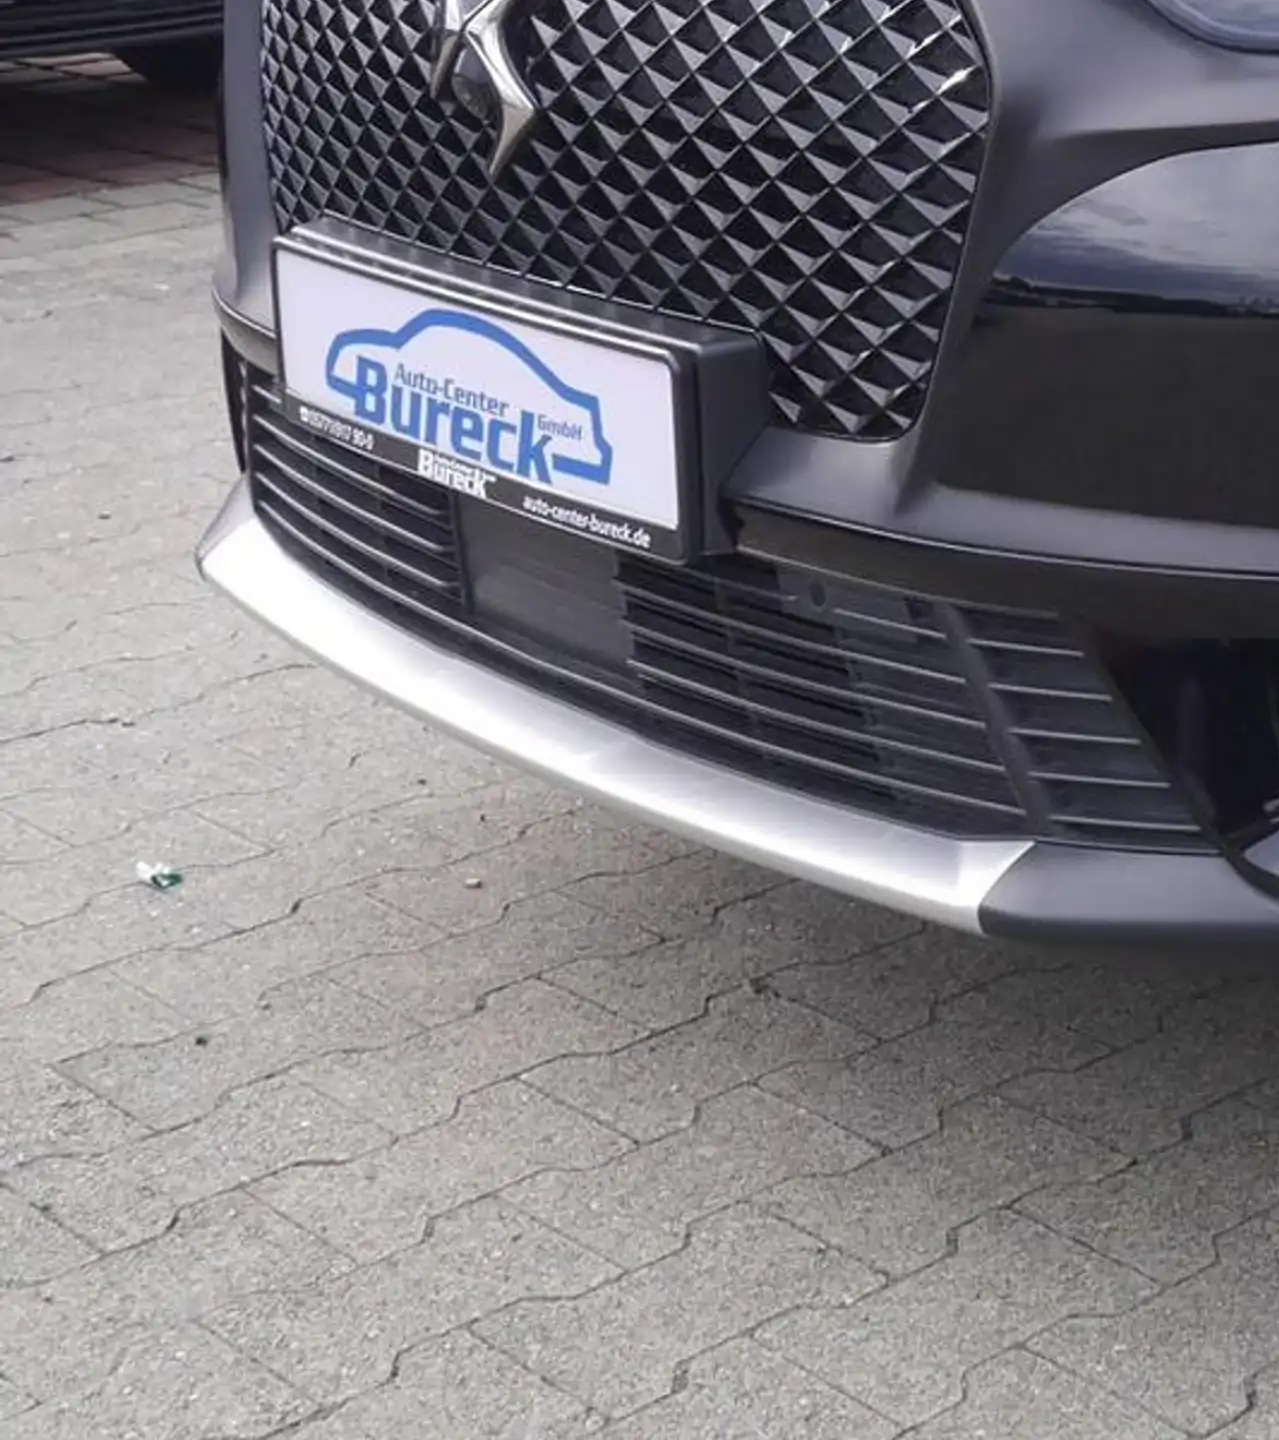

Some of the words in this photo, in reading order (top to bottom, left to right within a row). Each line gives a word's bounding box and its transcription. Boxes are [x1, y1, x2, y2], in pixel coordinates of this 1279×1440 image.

[393, 363, 509, 418] Auto-Center
[354, 355, 553, 485] Bureck
[537, 414, 583, 441] GmbH
[417, 448, 486, 500] Bureck
[522, 496, 651, 549] auto-center-bureck.de
